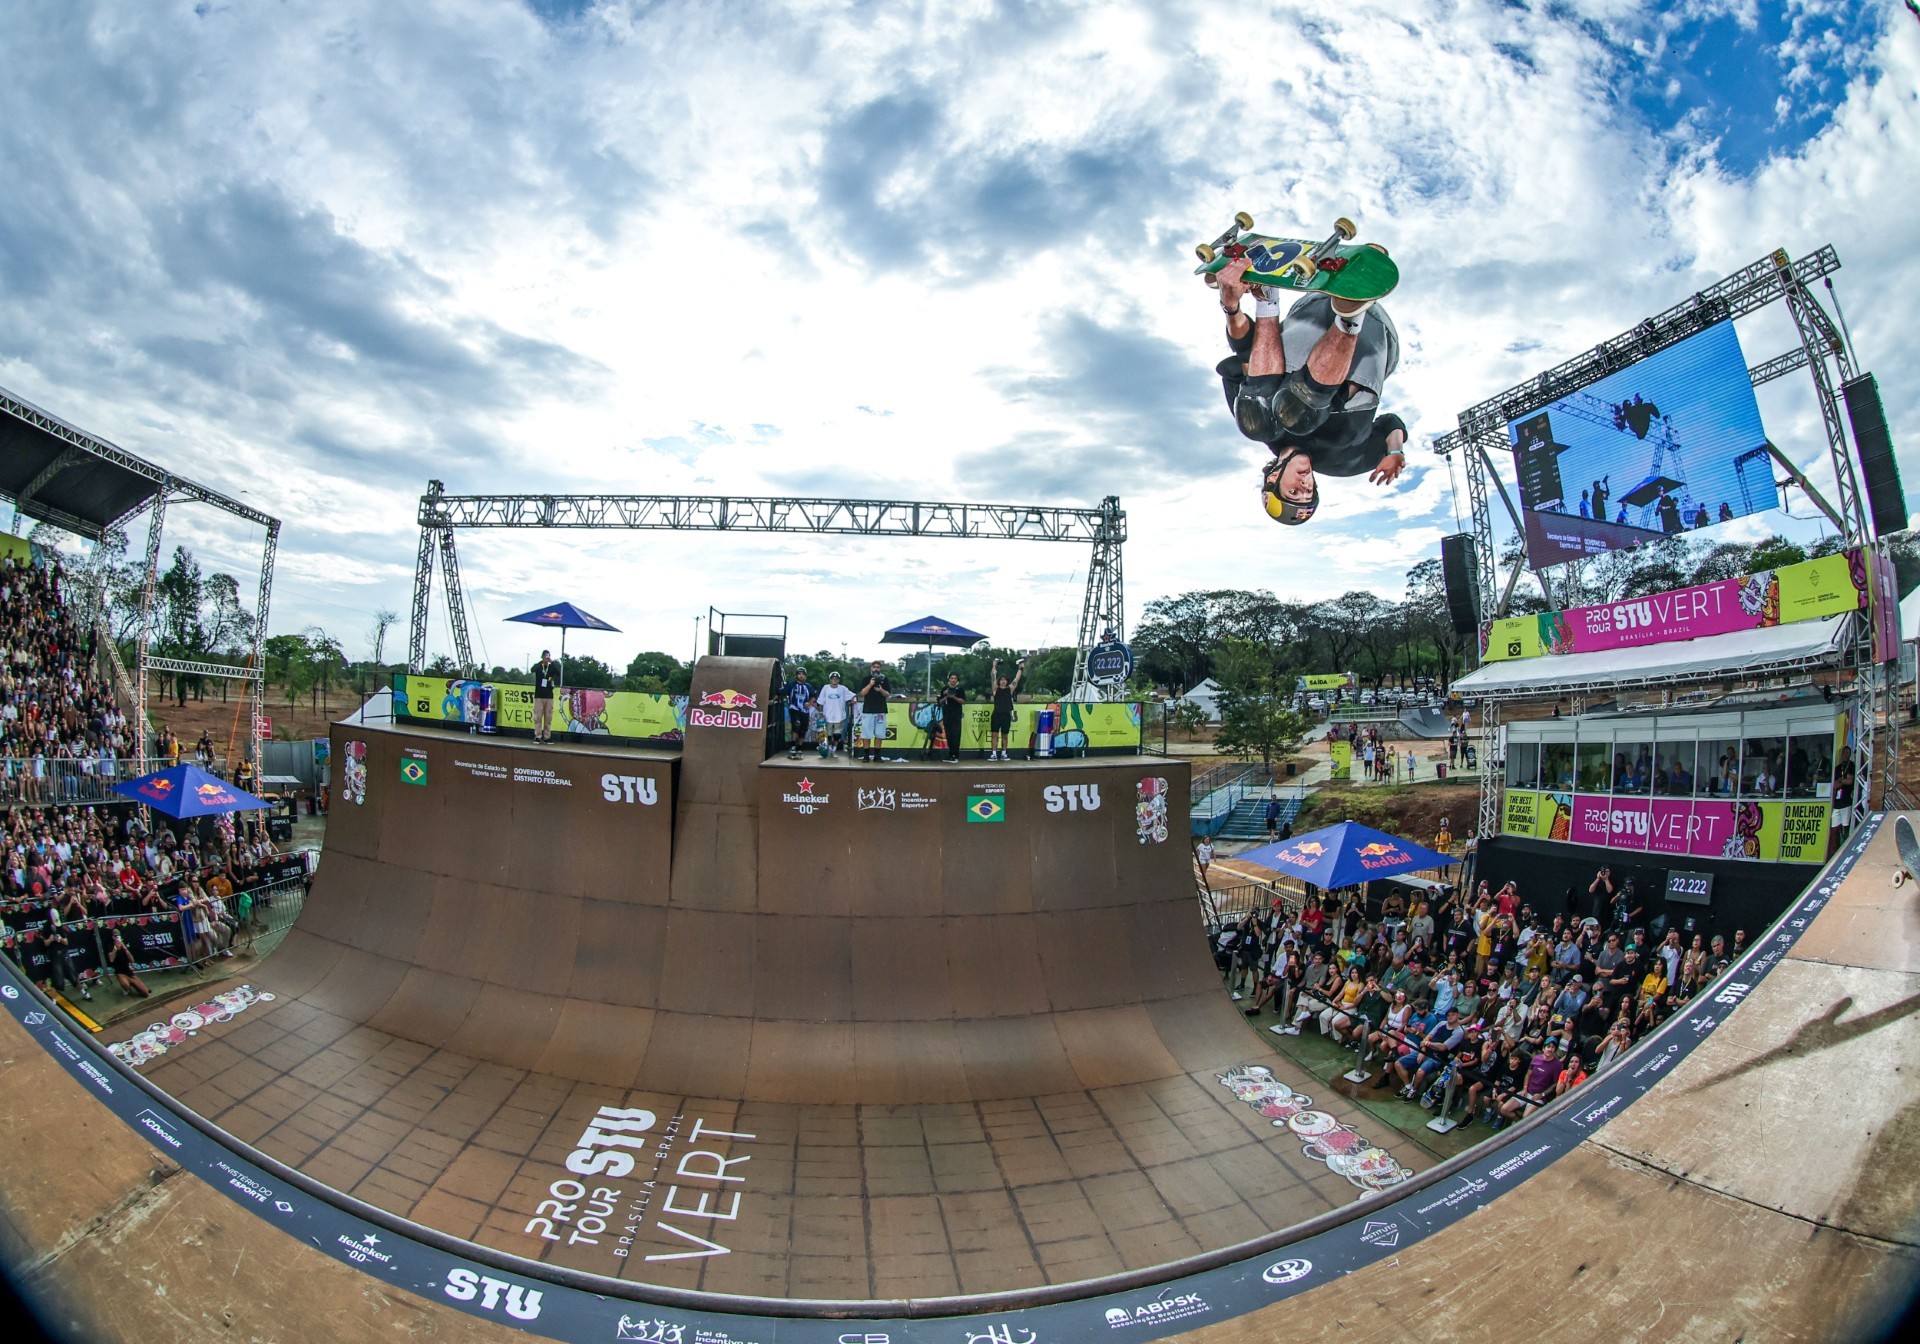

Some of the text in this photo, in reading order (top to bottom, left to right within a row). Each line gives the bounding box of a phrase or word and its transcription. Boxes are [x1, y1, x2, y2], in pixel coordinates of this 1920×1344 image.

[1586, 608, 1610, 623] PRO
[1613, 586, 1725, 631] STU VERT
[1587, 623, 1611, 634] TOUR
[1620, 626, 1691, 641] BRASÍLIA BRAZIL
[521, 691, 535, 704] ST
[505, 709, 533, 723] VER
[690, 708, 763, 729] Red Bull
[972, 730, 1018, 742] VET
[514, 768, 544, 777] GOVERNO
[514, 775, 572, 786] DISTRITO FEDERAL
[601, 774, 658, 806] STU
[783, 794, 829, 803] Heineken
[1043, 784, 1101, 813] STU
[1584, 809, 1608, 822] PRO
[1785, 805, 1825, 818] O MELHOR
[1508, 823, 1530, 833] THE TIME
[1584, 822, 1607, 833] TOUR
[1611, 810, 1720, 842] STU VERT
[1784, 819, 1821, 832] DO SKATE
[1782, 832, 1816, 845] O TEMPO
[1275, 849, 1318, 868] Red Bull
[1361, 852, 1412, 869] Red Bull
[1781, 845, 1801, 858] TODO
[1669, 877, 1707, 894] :22.222
[155, 932, 173, 945] STU
[1715, 983, 1750, 1004] STU
[141, 1117, 182, 1148] JCDecaux
[565, 1105, 656, 1178] STU
[1488, 1150, 1531, 1176] GOVERNO DO
[1494, 1144, 1551, 1180] DISTRITO FEDERAL
[217, 1161, 273, 1197] MINISTÉRIO DO
[613, 1114, 684, 1257] BRASÍLIA BRAZIL
[229, 1178, 268, 1203] ESPORTE
[645, 1118, 757, 1261] VERT
[524, 1179, 586, 1241] PRO
[568, 1187, 622, 1246] TOUR
[1360, 1223, 1397, 1242] INSTITUTO
[338, 1234, 390, 1263] Heineken
[444, 1268, 544, 1320] STU
[1135, 1292, 1202, 1317] ABPSK
[1111, 1314, 1156, 1329] Associação
[1157, 1305, 1195, 1319] Brasileira
